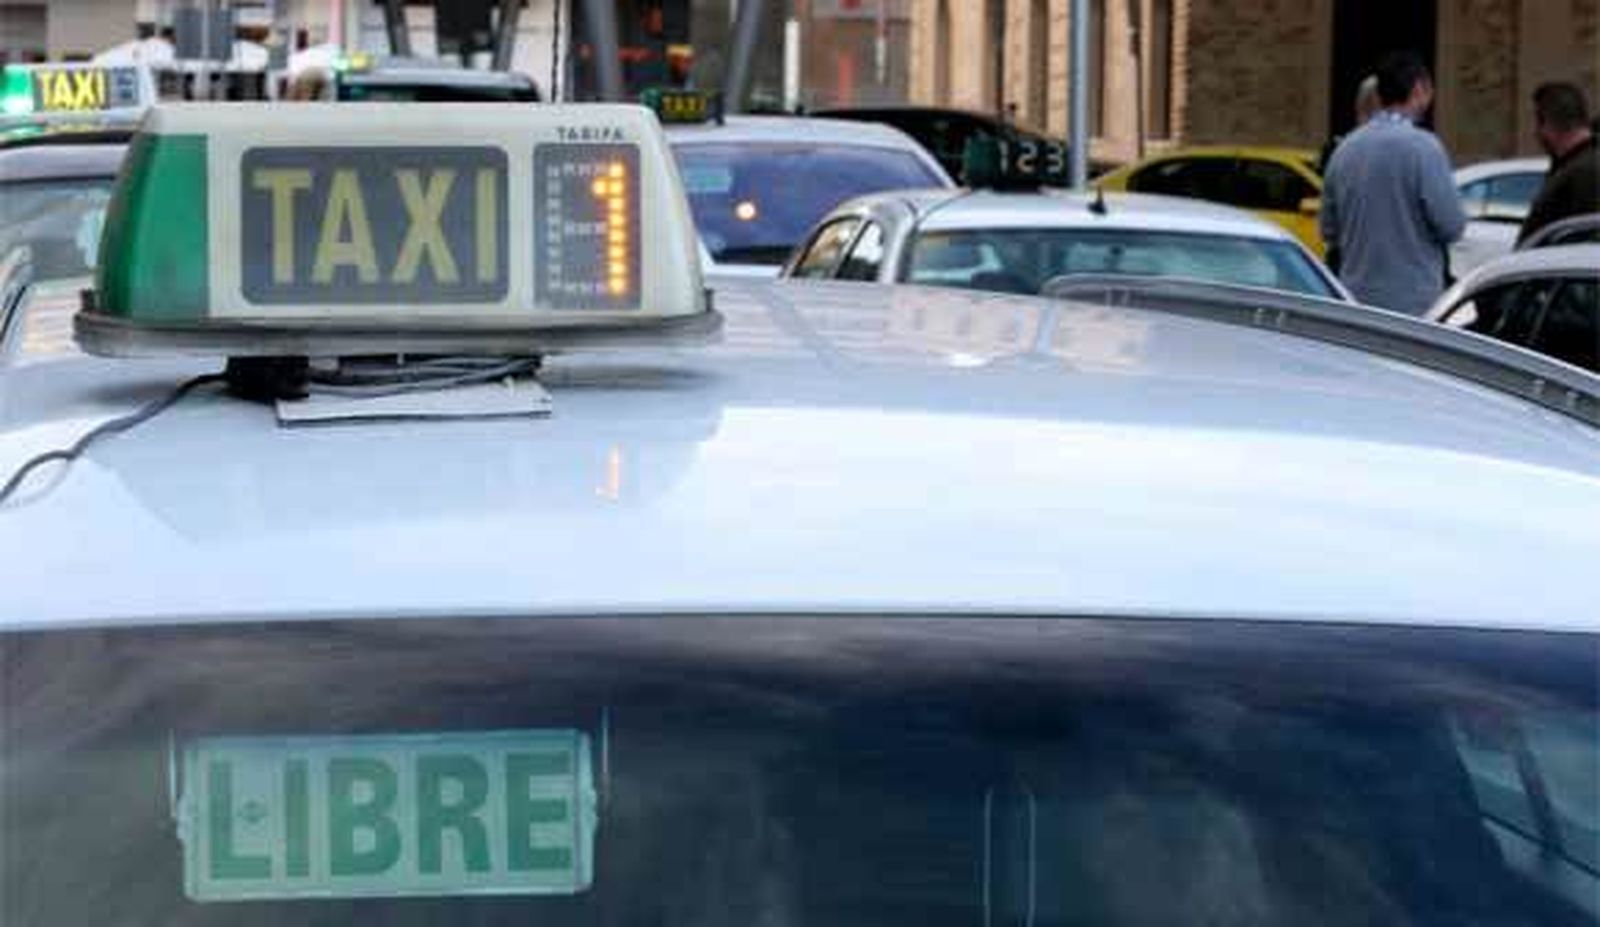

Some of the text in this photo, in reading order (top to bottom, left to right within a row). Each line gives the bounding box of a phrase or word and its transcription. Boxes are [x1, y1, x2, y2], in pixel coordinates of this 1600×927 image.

[42, 69, 105, 108] TAXI
[557, 127, 623, 141] TARIFA
[252, 168, 498, 285] TAXI
[592, 161, 627, 296] 1
[209, 752, 573, 879] LIBRE
